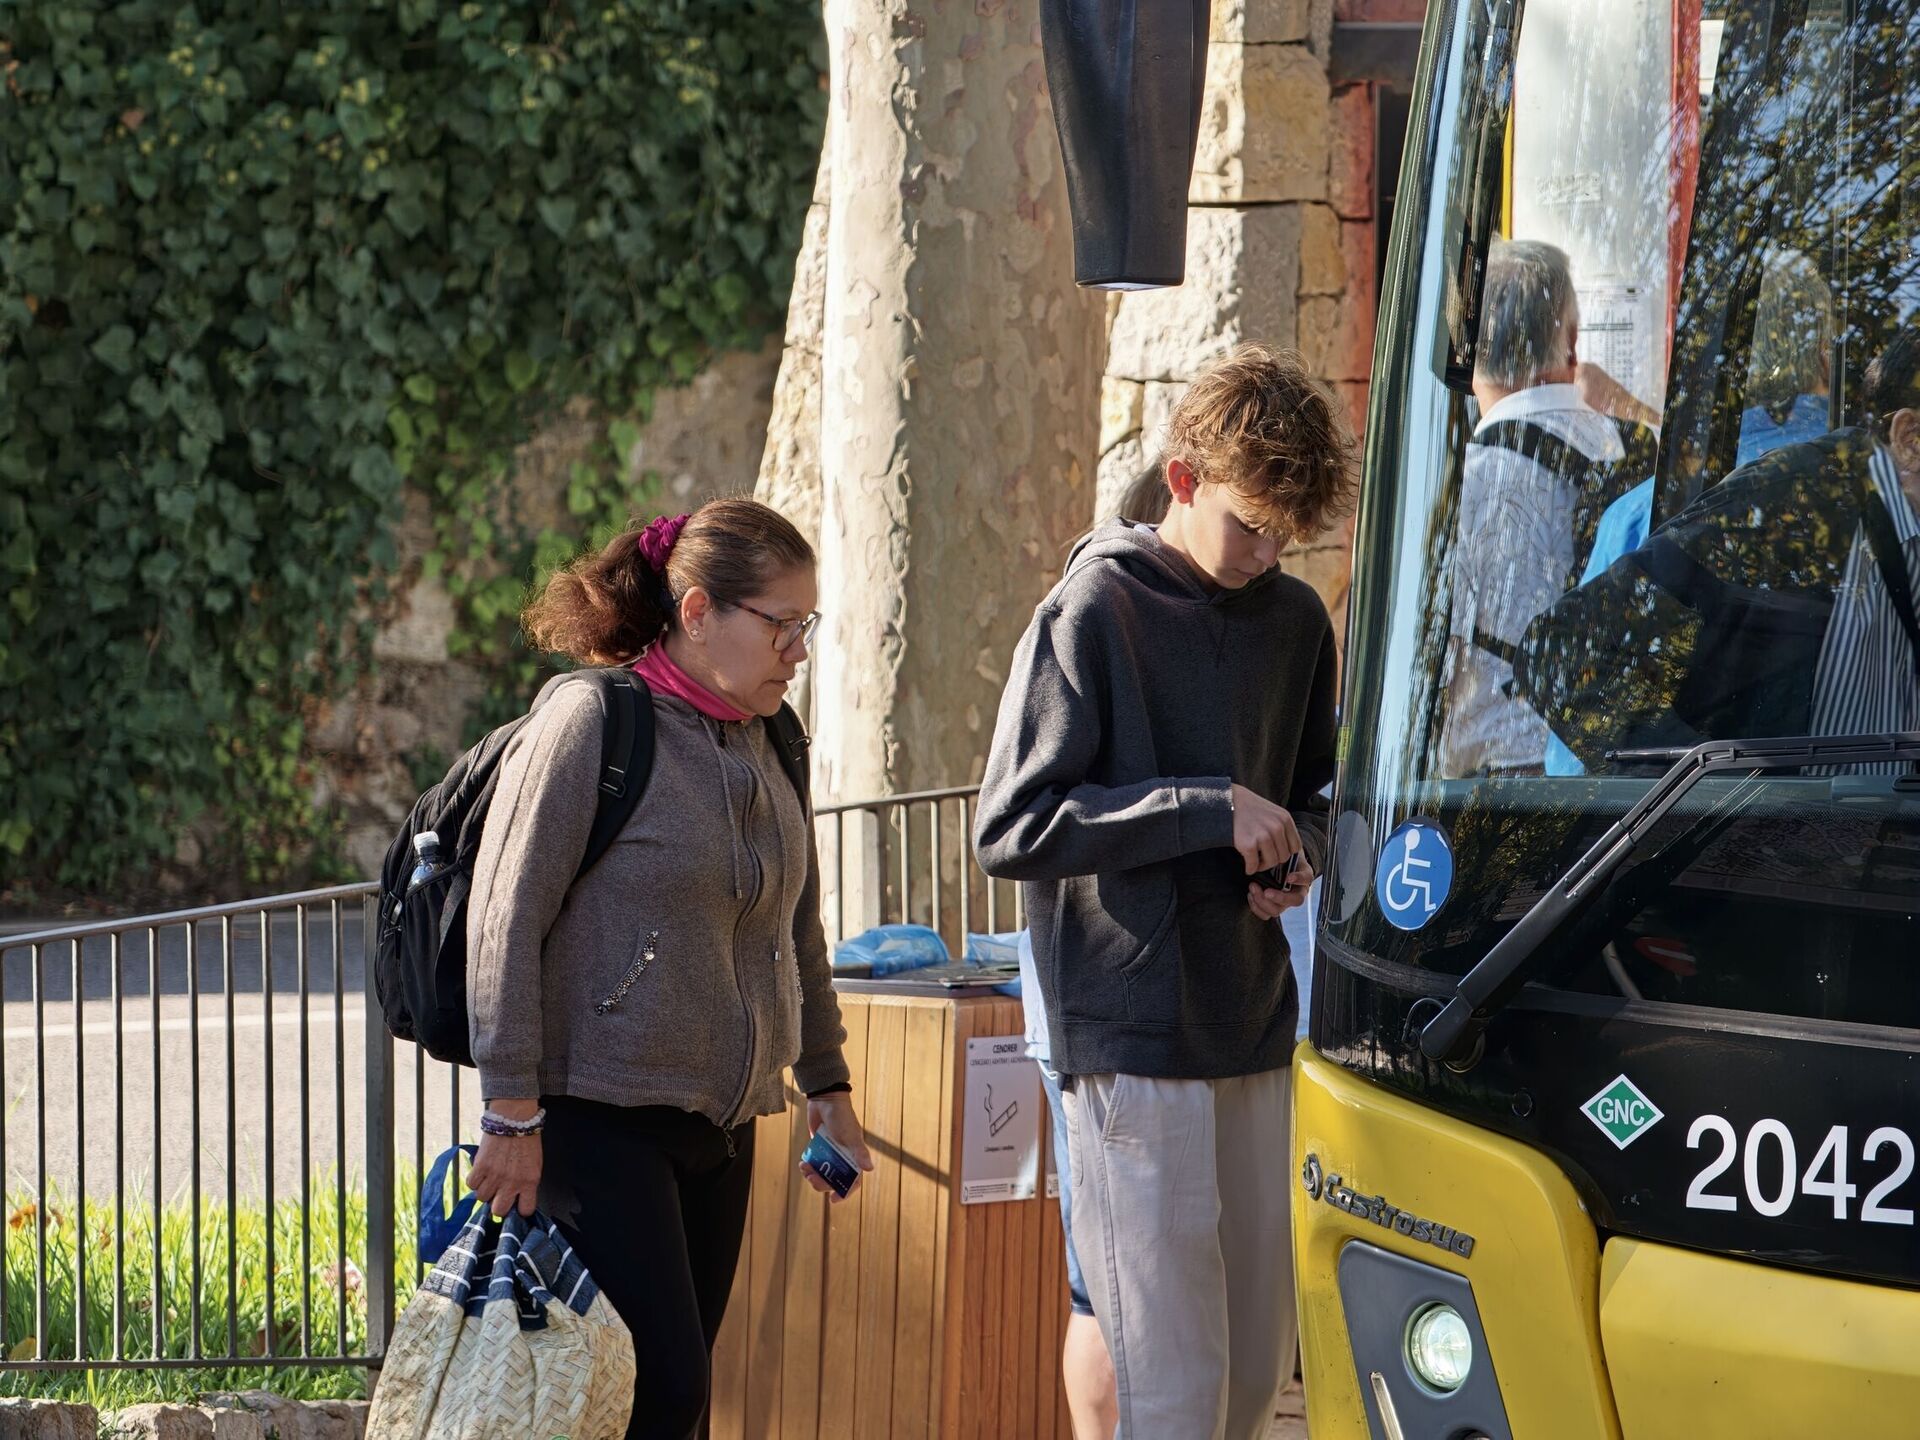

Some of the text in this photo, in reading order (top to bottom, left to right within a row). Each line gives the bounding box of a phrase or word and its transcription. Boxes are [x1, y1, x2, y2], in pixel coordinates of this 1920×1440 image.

[992, 1043, 1018, 1054] CENDRER
[1597, 1097, 1645, 1126] GNC
[1686, 1114, 1915, 1225] 2042
[1323, 1172, 1476, 1259] Castrosua
